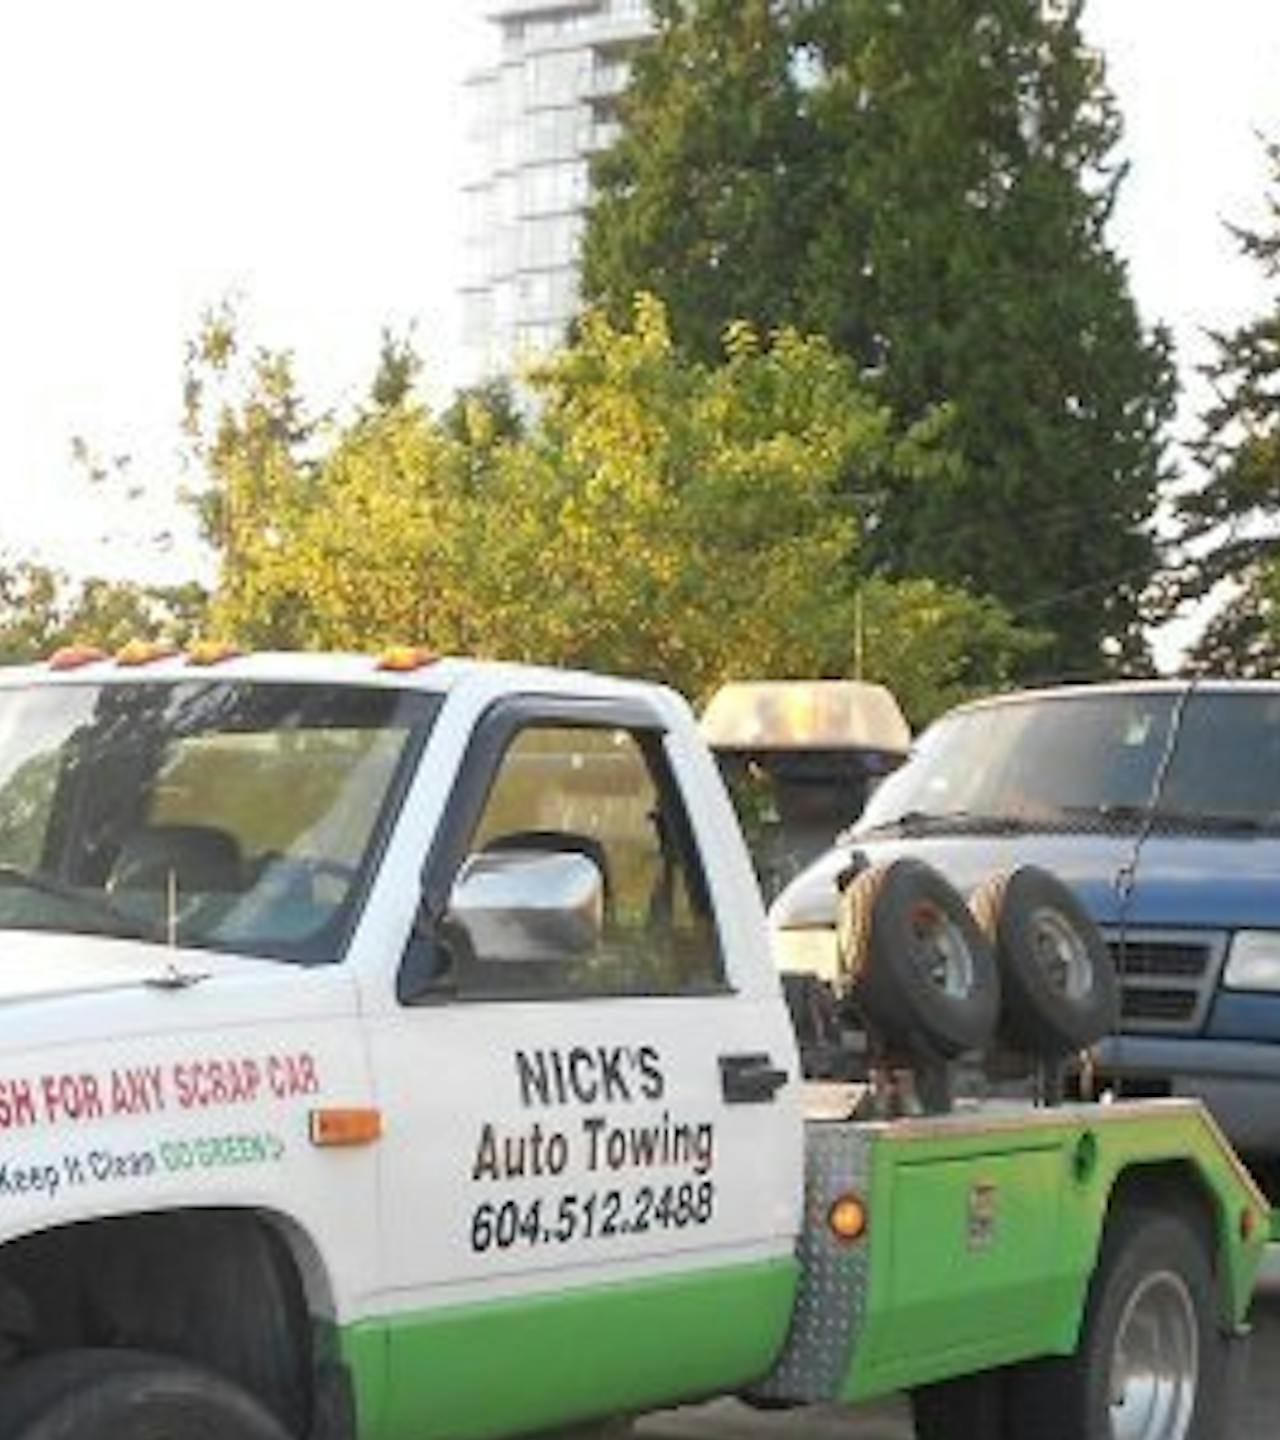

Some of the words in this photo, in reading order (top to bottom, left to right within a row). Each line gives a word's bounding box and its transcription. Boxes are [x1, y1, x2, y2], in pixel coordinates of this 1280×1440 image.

[40, 1073, 104, 1124] FOR
[110, 1064, 165, 1114] ANY
[173, 1058, 260, 1109] SCRAP
[267, 1052, 321, 1098] CAR
[515, 1046, 665, 1105] NICK'S
[87, 1150, 156, 1182] Clean
[472, 1122, 569, 1181] Auto
[581, 1110, 713, 1176] Towing
[470, 1180, 714, 1251] 604.512.2488
